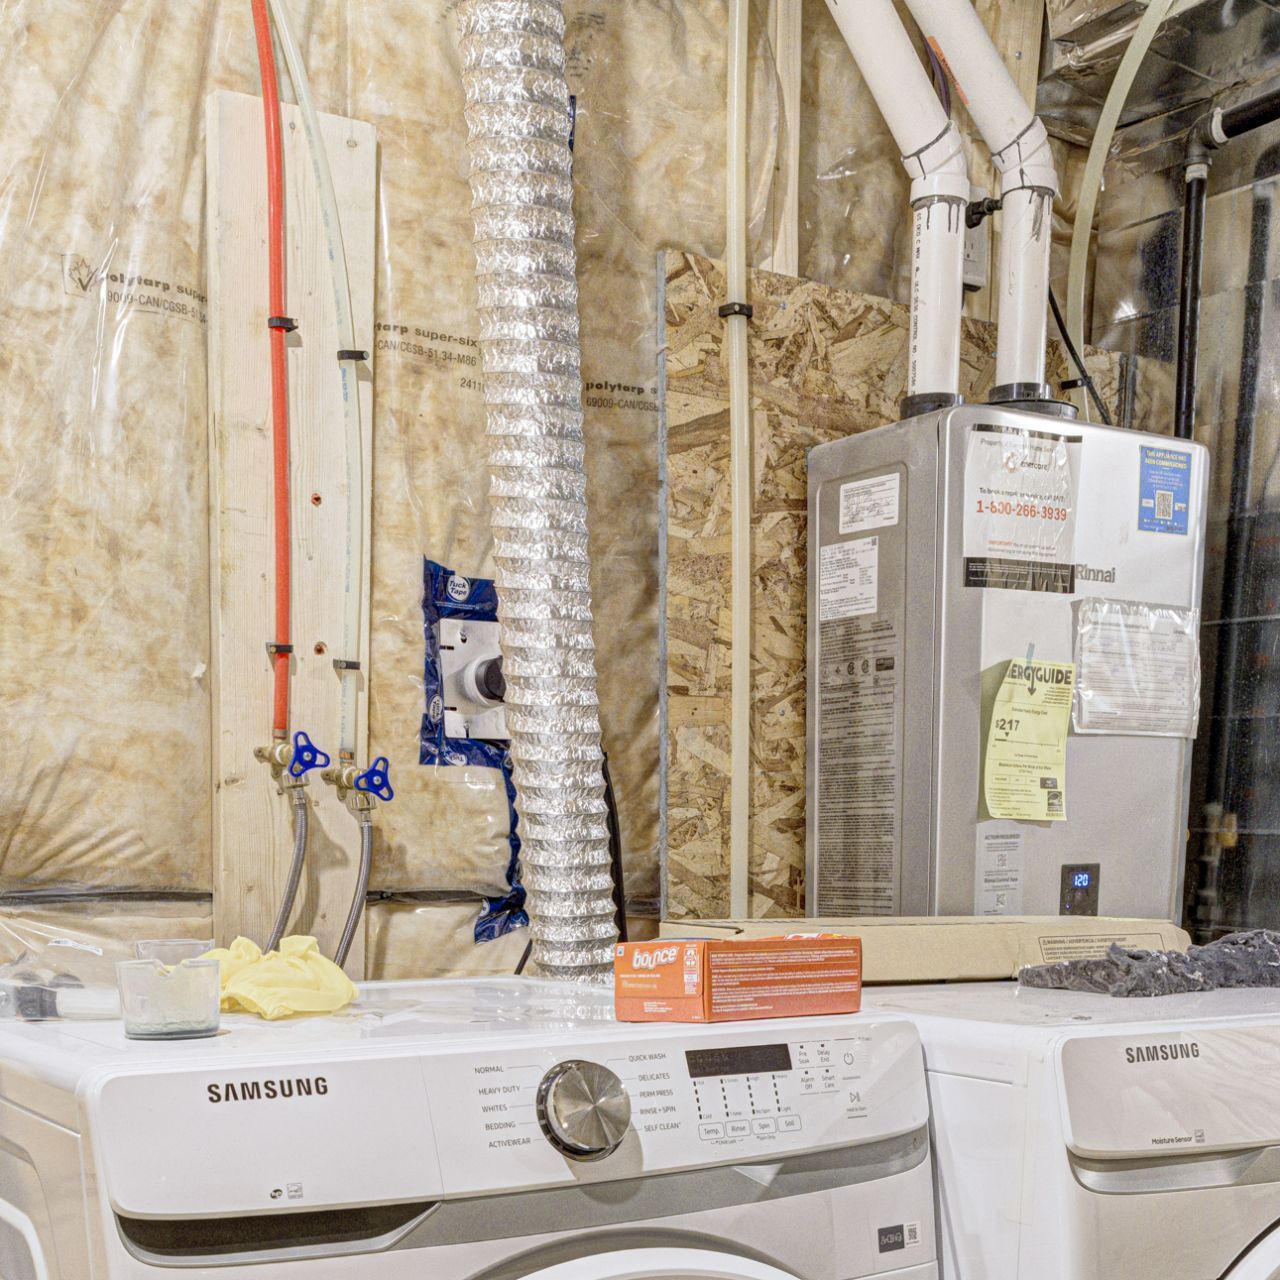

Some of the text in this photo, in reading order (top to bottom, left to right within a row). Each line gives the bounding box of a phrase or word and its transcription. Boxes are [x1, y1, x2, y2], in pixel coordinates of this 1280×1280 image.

[586, 382, 645, 395] polytarp
[1076, 564, 1116, 583] Rinnai
[449, 580, 466, 589] Tuck
[451, 588, 467, 596] Tape
[995, 718, 1020, 731] $217
[1074, 873, 1089, 887] 120
[632, 946, 678, 970] bounce
[628, 1054, 647, 1062] QUICK
[1125, 1042, 1200, 1064] SAMSUNG
[474, 1066, 504, 1075] NORMAL
[638, 1073, 671, 1081] DELICATES
[207, 1077, 329, 1103] SAMSUNG
[478, 1085, 521, 1096] HEAVY DUTY
[481, 1104, 508, 1113] WHITES
[485, 1121, 517, 1131] BEDDING
[644, 1124, 658, 1132] SELF
[488, 1137, 531, 1149] ACTIVEWEAR
[1151, 1135, 1192, 1145] Moisture Sensor
